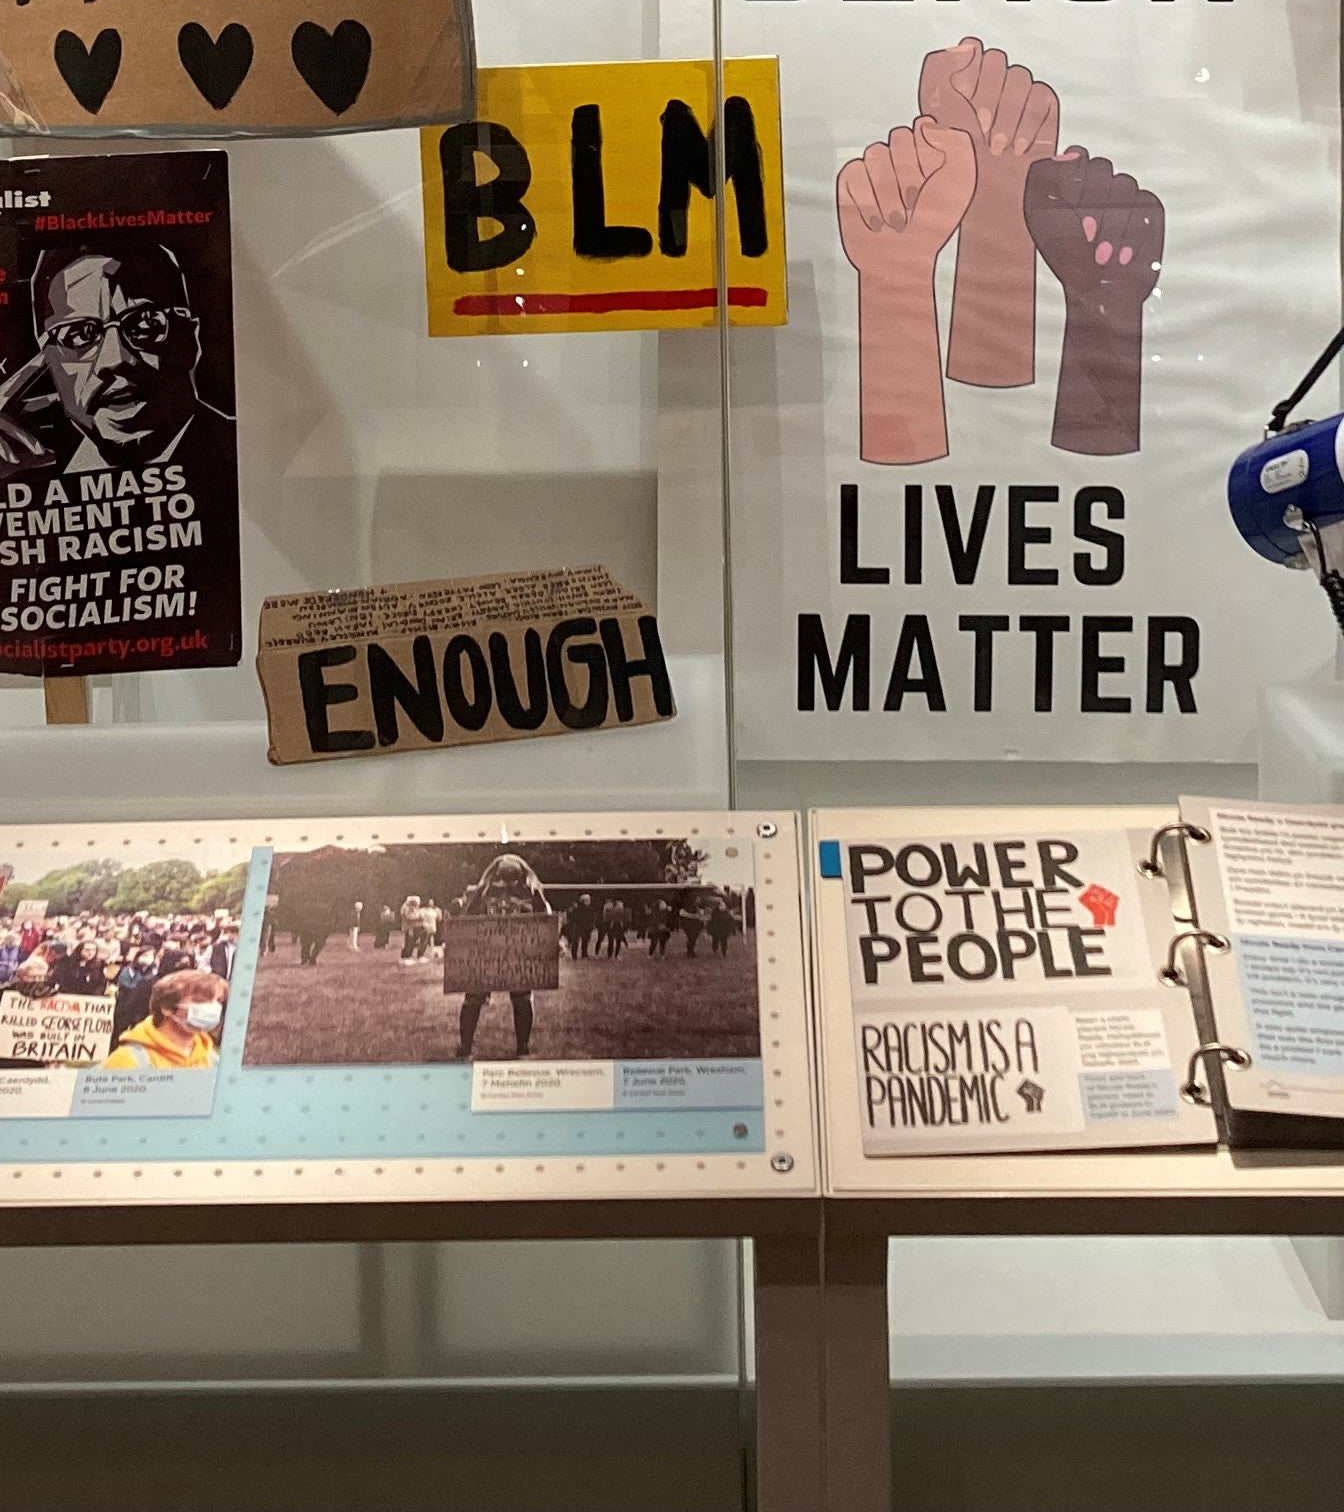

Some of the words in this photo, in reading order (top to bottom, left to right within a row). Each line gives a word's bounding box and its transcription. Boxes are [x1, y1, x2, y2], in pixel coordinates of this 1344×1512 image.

[440, 96, 768, 273] BLM
[34, 209, 213, 231] #BlackLivesMatter
[44, 479, 69, 506] A
[79, 465, 186, 502] MASS
[145, 493, 195, 521] TO
[58, 520, 203, 562] RACISM
[840, 483, 1126, 586] LIVES
[10, 571, 111, 603] FIGHT
[120, 564, 185, 595] FOR
[0, 591, 198, 632] SOCIALISM!
[298, 615, 674, 753] ENOUGH
[796, 613, 1199, 714] MATTER
[848, 839, 1085, 893] POWER
[851, 892, 943, 935] TO
[944, 887, 1079, 931] THE
[859, 926, 1112, 985] PEOPLE
[0, 1015, 38, 1026] KILLED
[84, 1001, 113, 1015] THAT
[12, 1040, 97, 1061] BRITAIN
[861, 1021, 973, 1076] RACISM
[978, 1019, 1011, 1075] IS
[1016, 1017, 1041, 1074] A
[867, 1068, 1010, 1129] PANDEMIC
